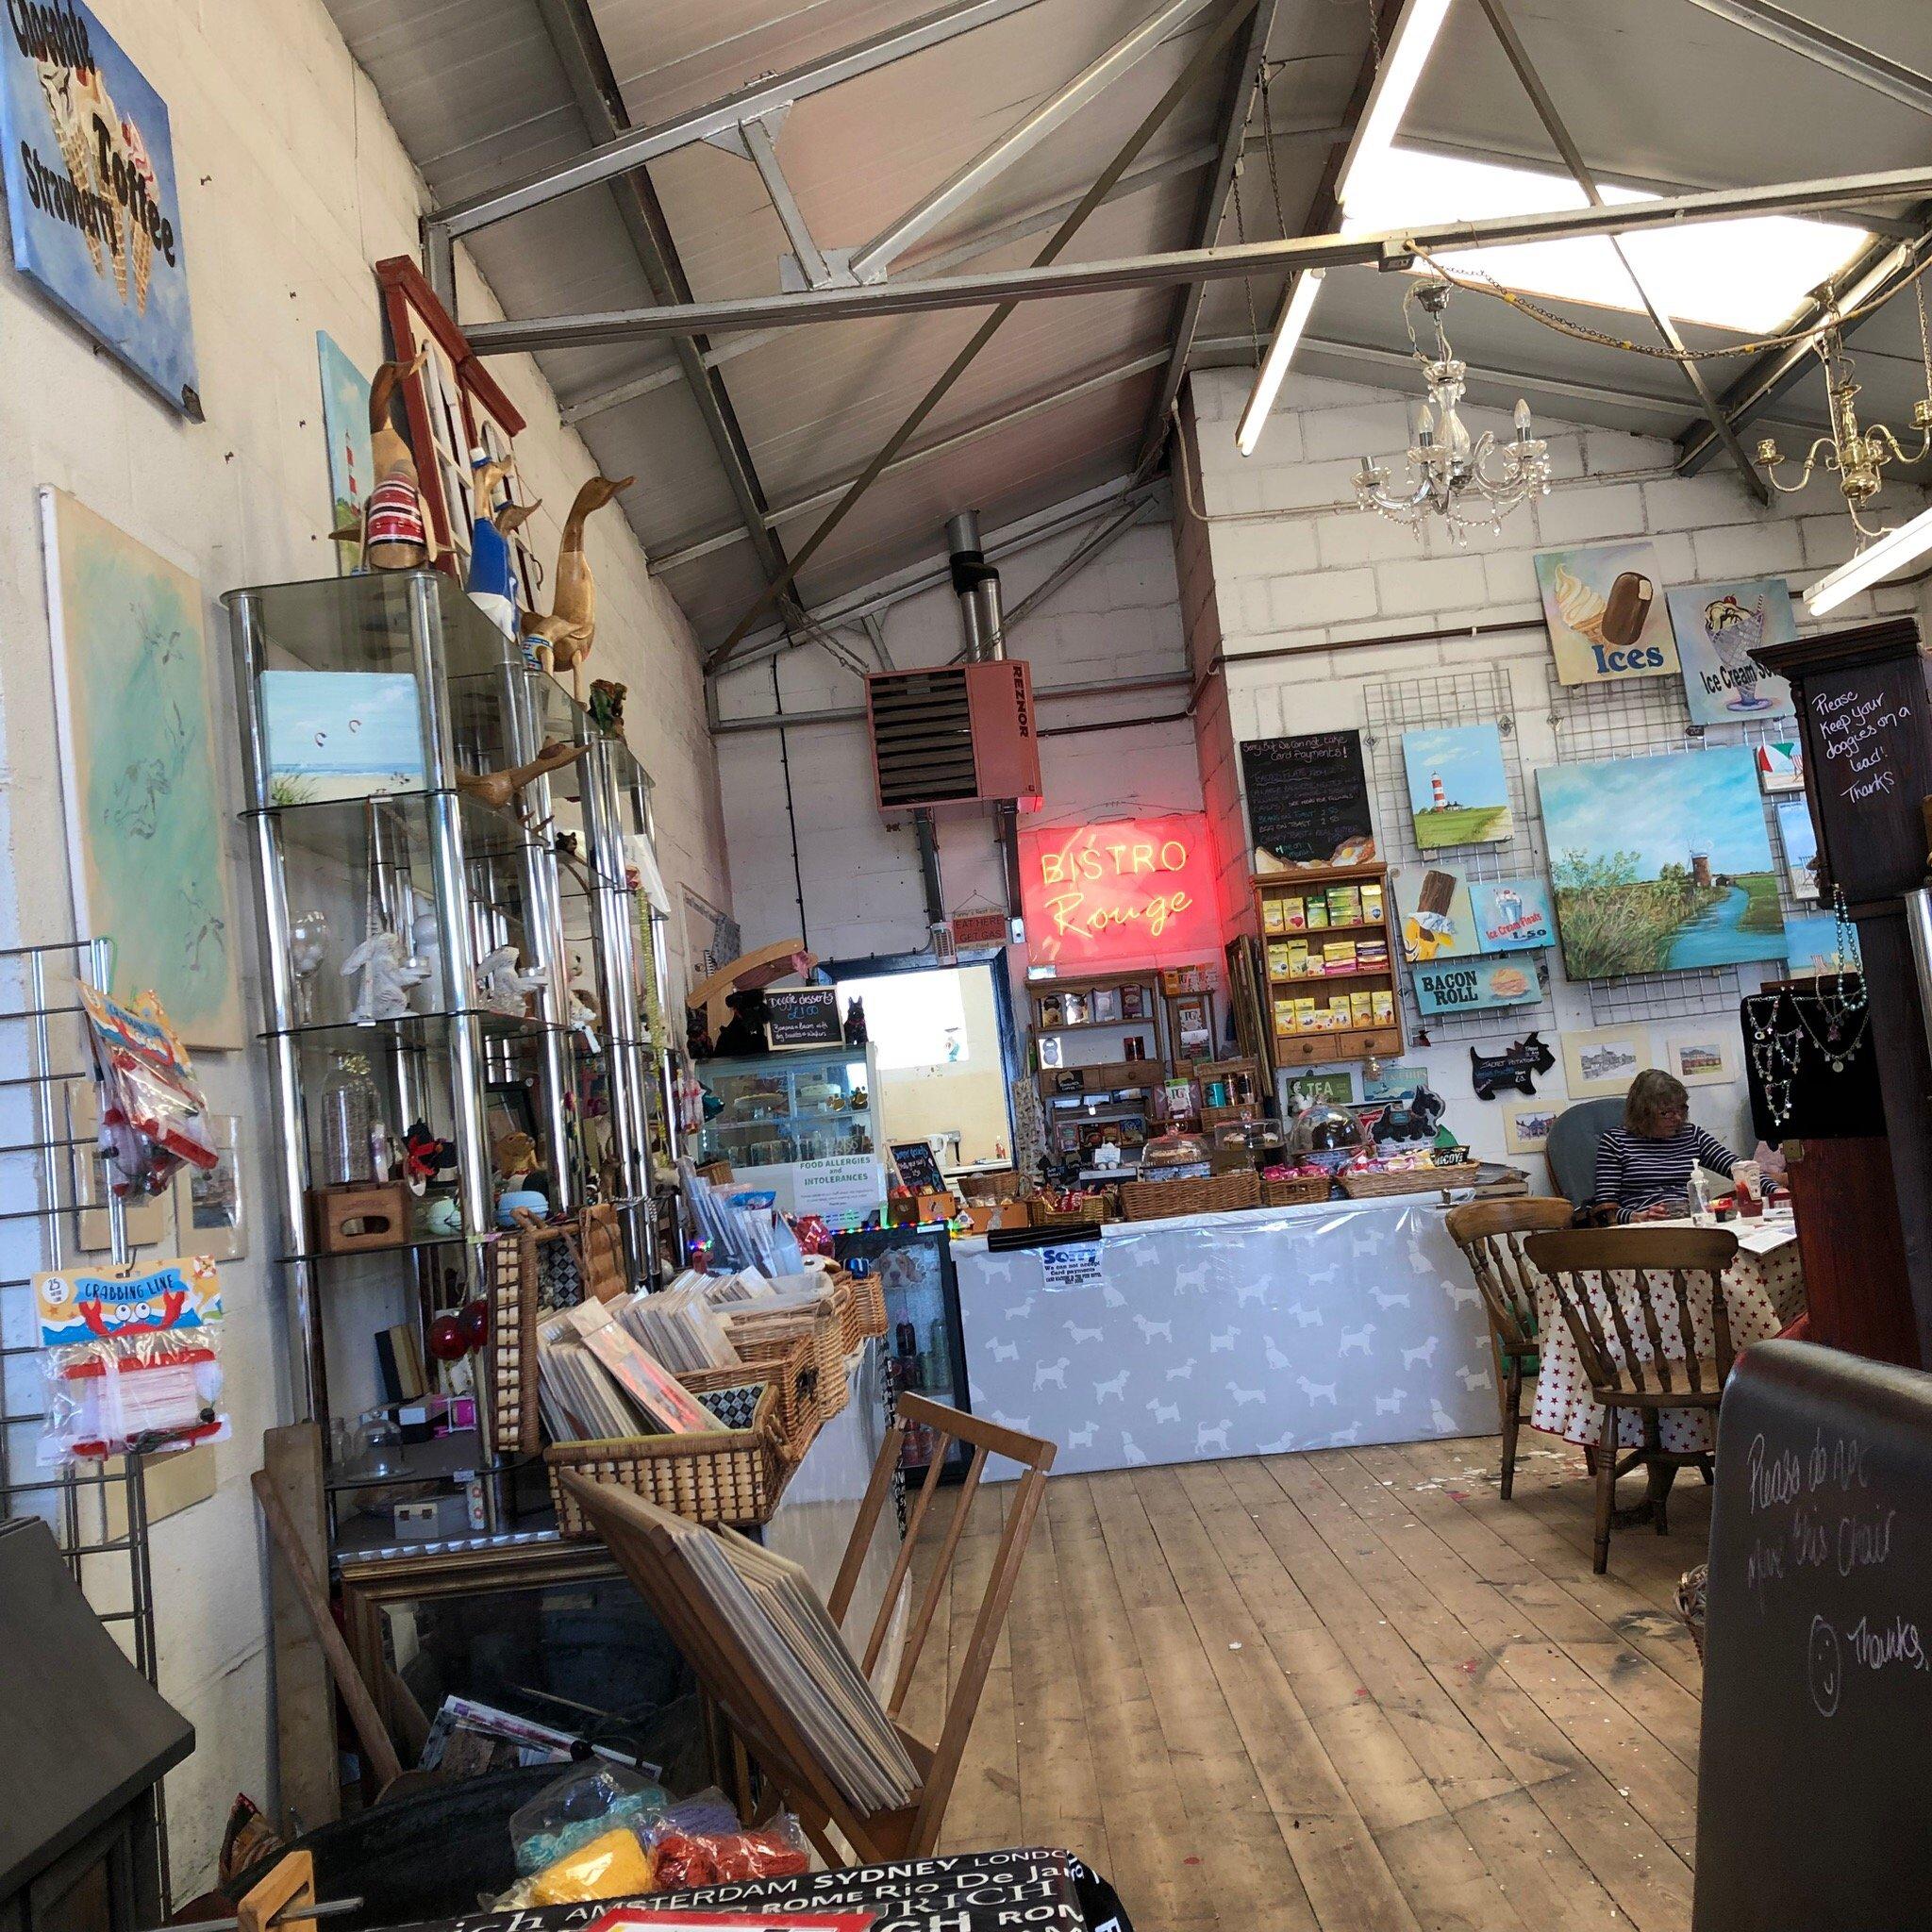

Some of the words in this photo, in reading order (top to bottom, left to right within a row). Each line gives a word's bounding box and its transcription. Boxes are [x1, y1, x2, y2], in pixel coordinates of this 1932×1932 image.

[1591, 643, 1665, 674] Ices
[1700, 671, 1722, 694] Ice
[1720, 662, 1758, 689] Cream
[1012, 665, 1029, 739] REZNOR
[1811, 690, 1858, 715] Please
[1851, 691, 1885, 725] your
[1825, 724, 1877, 760] doggies
[1877, 711, 1898, 731] on
[1898, 706, 1911, 718] a
[1840, 771, 1895, 804] Thanks
[1041, 840, 1188, 886] BISTRO
[955, 919, 973, 929] EAT
[975, 915, 1002, 924] HERE
[1044, 891, 1193, 939] Rouge
[1485, 930, 1498, 941] Ice
[1497, 922, 1521, 935] Cream
[1520, 912, 1542, 926] Floats
[981, 929, 1002, 939] GAS
[1421, 971, 1478, 992] BACON
[769, 993, 797, 1011] Doggie
[798, 991, 834, 1006] desserts
[1433, 986, 1479, 1007] ROLL
[1307, 1081, 1334, 1096] TEA
[800, 1161, 824, 1170] FOOD
[824, 1157, 871, 1168] ALLERGIES
[804, 1173, 869, 1186] INTOLERANCES
[48, 1278, 60, 1291] 25
[1066, 1267, 1096, 1275] payments
[85, 1282, 144, 1301] CRABBING
[147, 1274, 175, 1295] LINE
[813, 1857, 960, 1889] SYDNEY
[974, 1850, 1068, 1867] LONDO
[761, 1890, 863, 1915] ROME
[875, 1882, 939, 1905] Rio
[957, 1866, 1011, 1889] De
[854, 1880, 1058, 1918] URICH
[998, 1904, 1084, 1925] ROM
